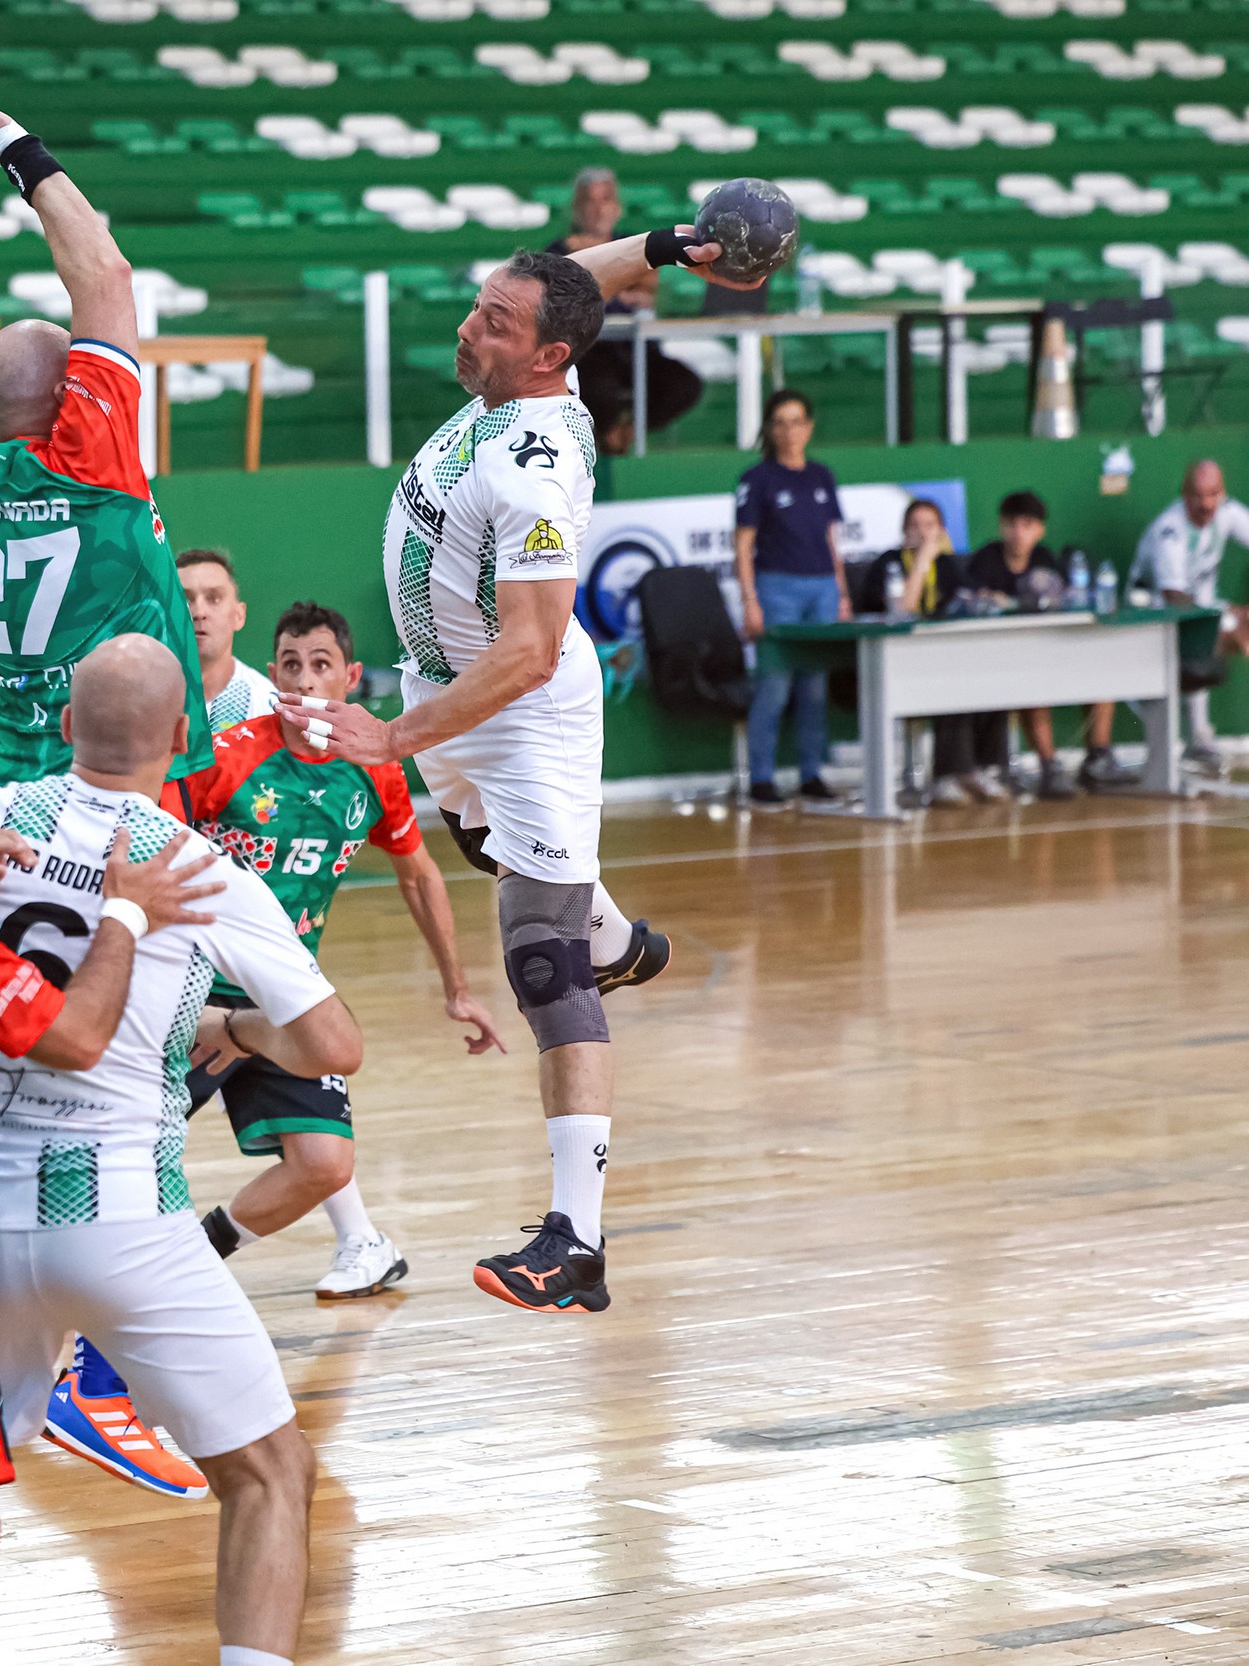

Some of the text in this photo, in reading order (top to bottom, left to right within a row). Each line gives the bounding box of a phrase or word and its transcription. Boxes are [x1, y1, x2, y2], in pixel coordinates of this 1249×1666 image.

[8, 163, 26, 193] Kempa
[402, 459, 447, 532] ristal
[281, 838, 329, 876] 15
[546, 848, 570, 859] cdt
[41, 854, 106, 895] RODR
